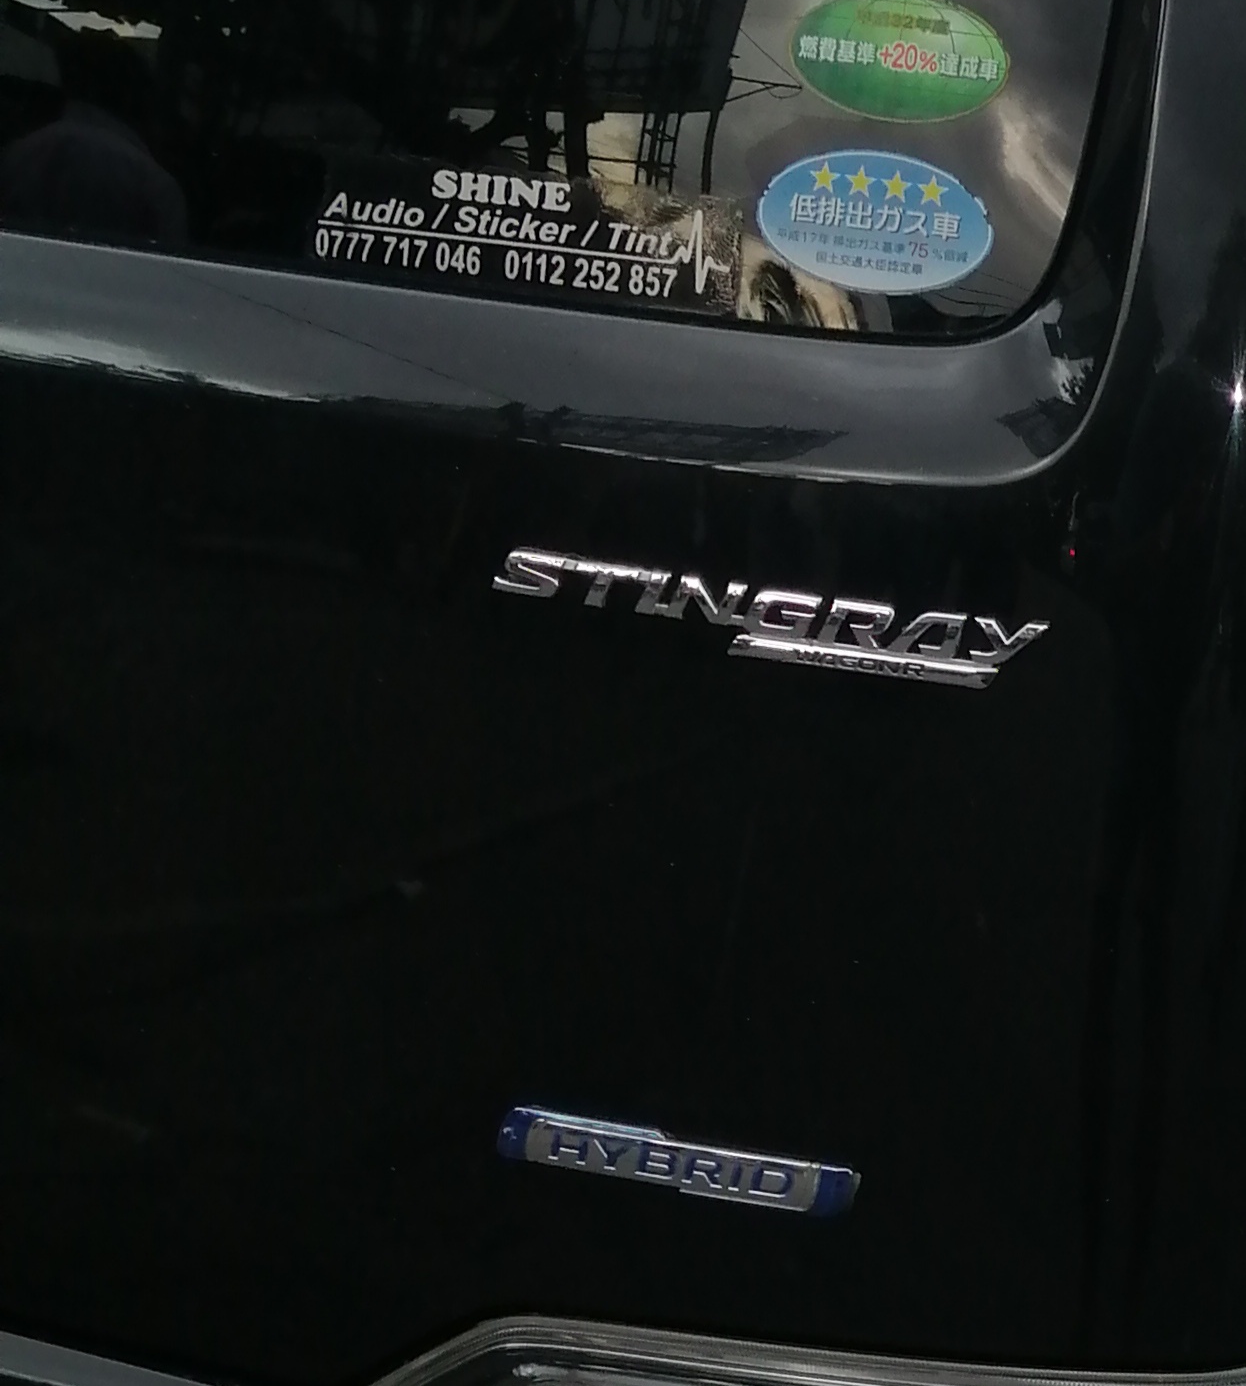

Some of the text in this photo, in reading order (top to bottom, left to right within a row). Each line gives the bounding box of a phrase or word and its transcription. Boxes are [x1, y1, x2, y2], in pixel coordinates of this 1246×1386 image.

[325, 192, 672, 256] Audio / Sticker / Tint
[432, 169, 571, 213] SHINE
[790, 192, 962, 241] 低排出ガス車
[315, 229, 677, 298] 0777 717 046 0112 252 857
[493, 547, 1051, 663] STINGRAY
[548, 1131, 794, 1199] HYBRID
